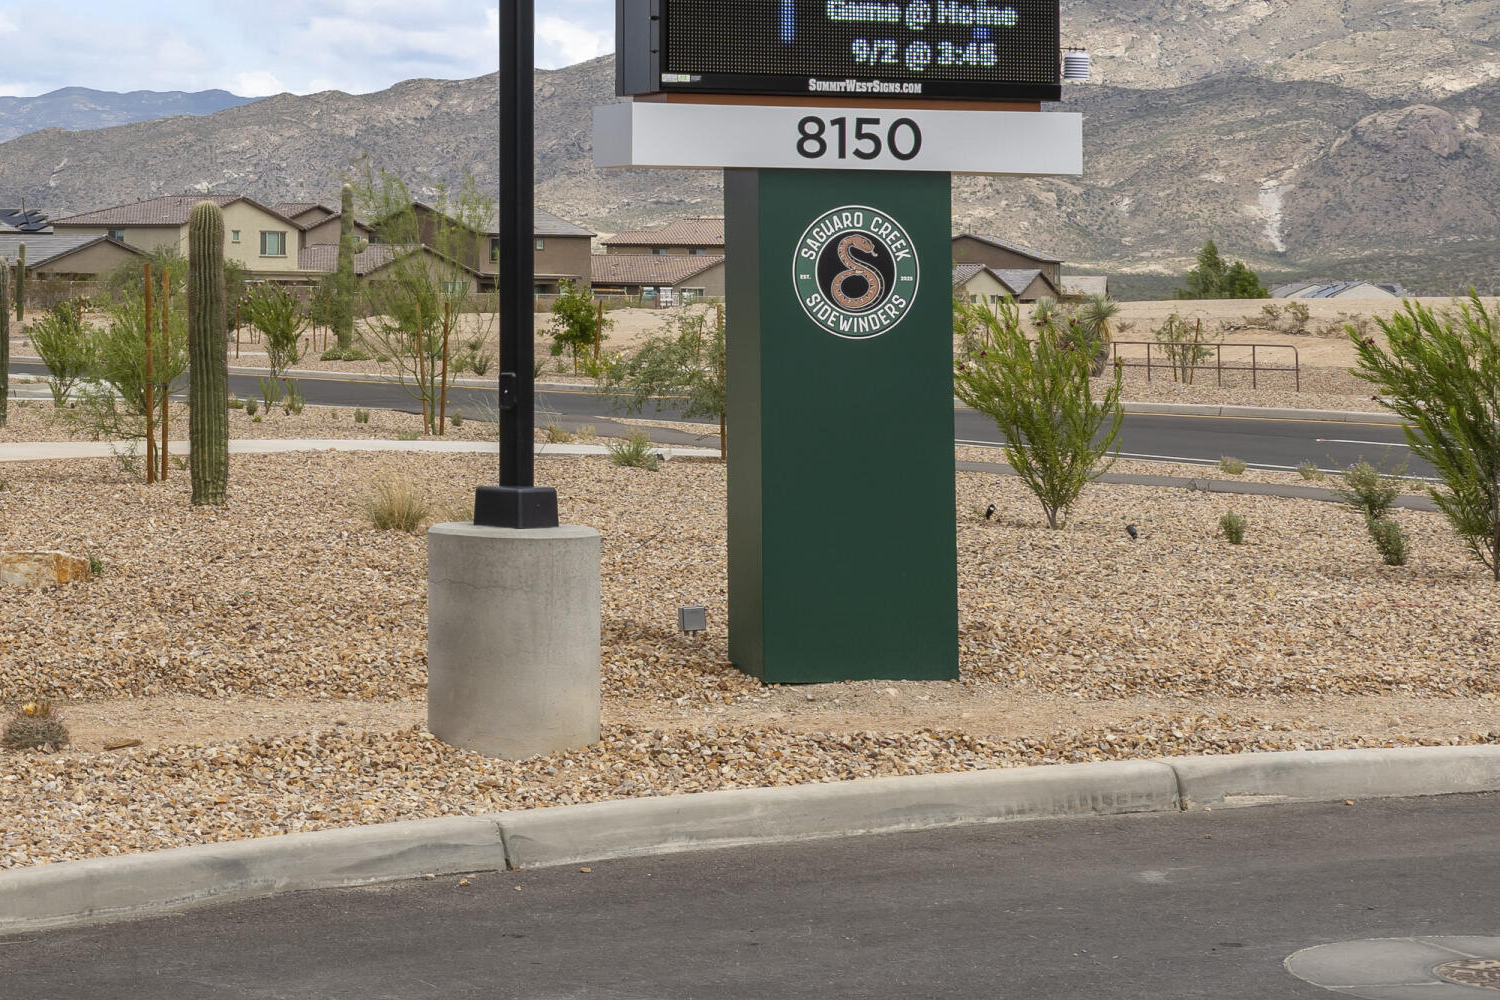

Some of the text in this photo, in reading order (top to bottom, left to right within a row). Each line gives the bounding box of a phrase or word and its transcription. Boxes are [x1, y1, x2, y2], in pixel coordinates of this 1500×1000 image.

[906, 0, 931, 30] @
[937, 0, 1018, 26] Home
[852, 39, 998, 71] 9/2 @ 3:45
[796, 116, 922, 161] 8150
[800, 211, 912, 262] SAGUARO CREEK
[806, 293, 907, 333] SIDEWINDERS
